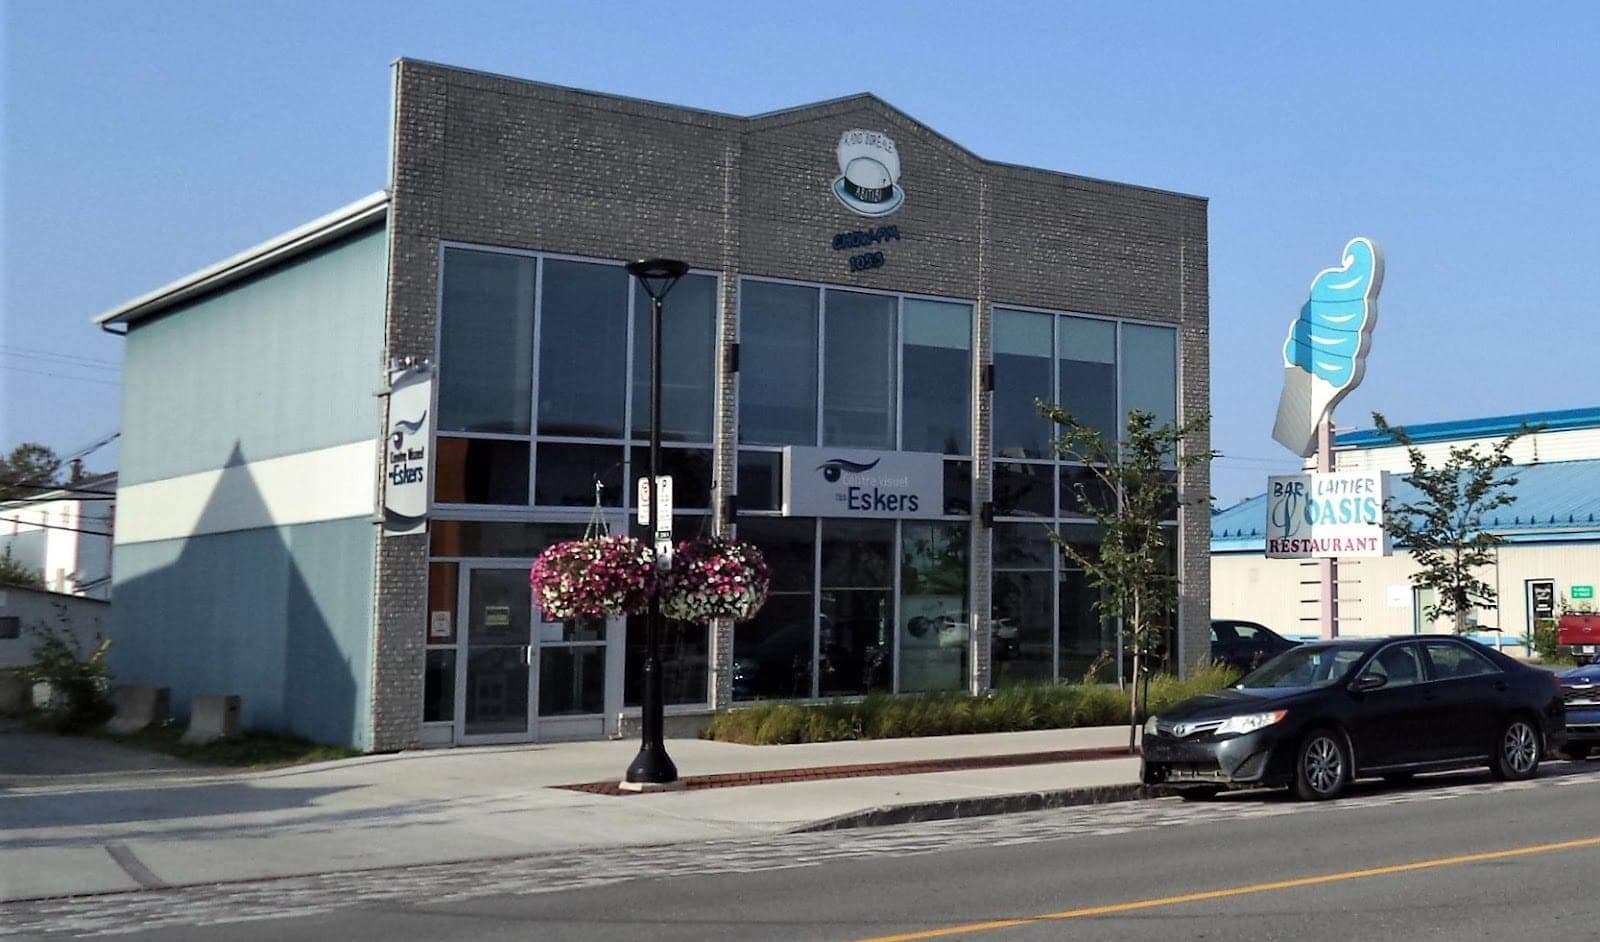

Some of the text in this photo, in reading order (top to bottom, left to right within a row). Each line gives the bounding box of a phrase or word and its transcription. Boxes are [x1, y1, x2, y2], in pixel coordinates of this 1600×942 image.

[393, 464, 423, 486] Eskers
[1274, 478, 1375, 497] BAR LAITIER
[848, 486, 919, 512] Eskers
[1269, 537, 1378, 553] RESTAURANT
